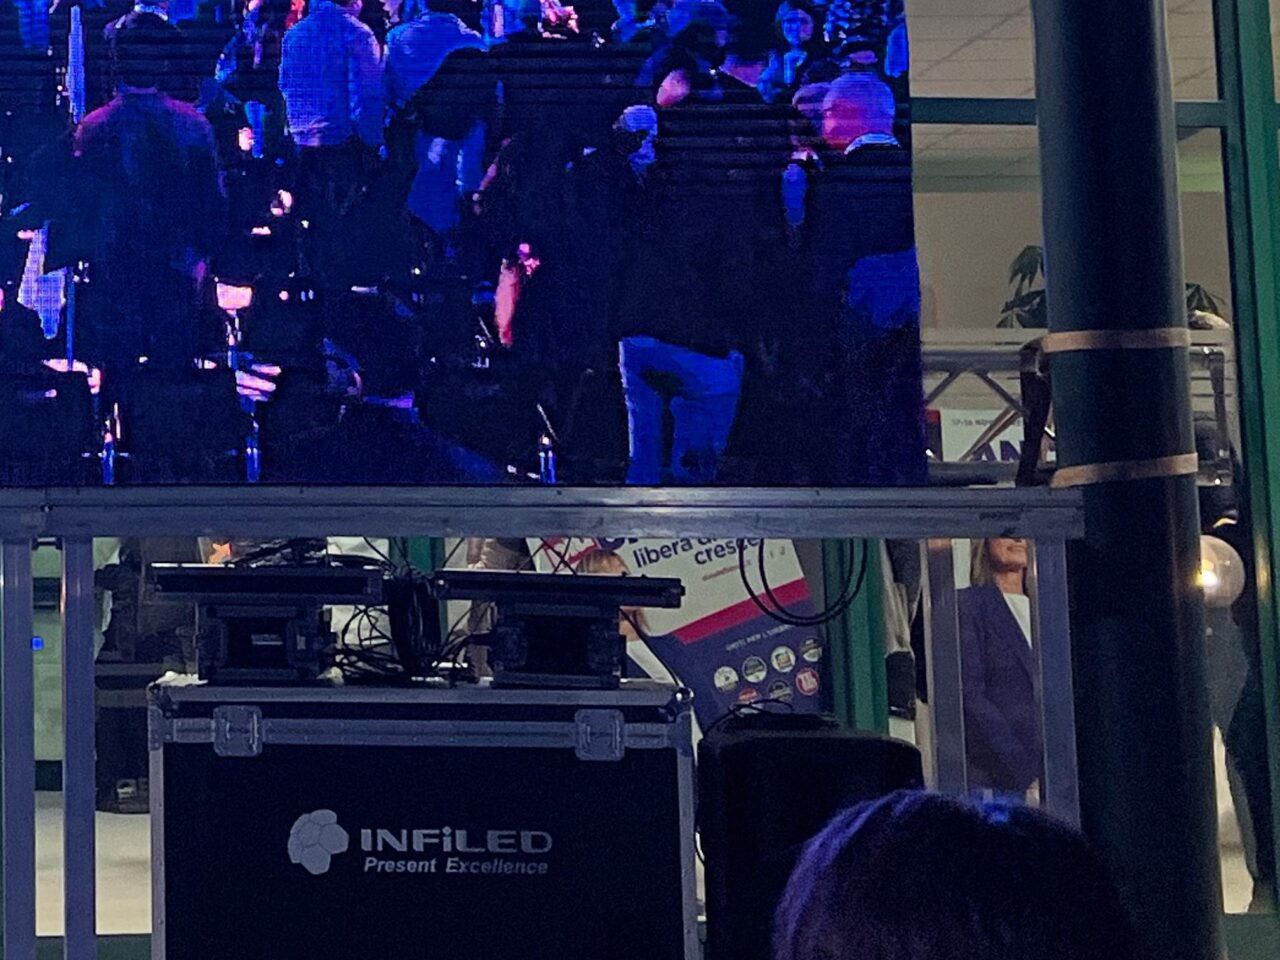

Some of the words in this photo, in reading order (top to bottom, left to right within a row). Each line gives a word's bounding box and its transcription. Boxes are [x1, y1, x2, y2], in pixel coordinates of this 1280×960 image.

[632, 538, 694, 569] libera
[363, 856, 438, 874] Present
[444, 856, 550, 875] Excellence
